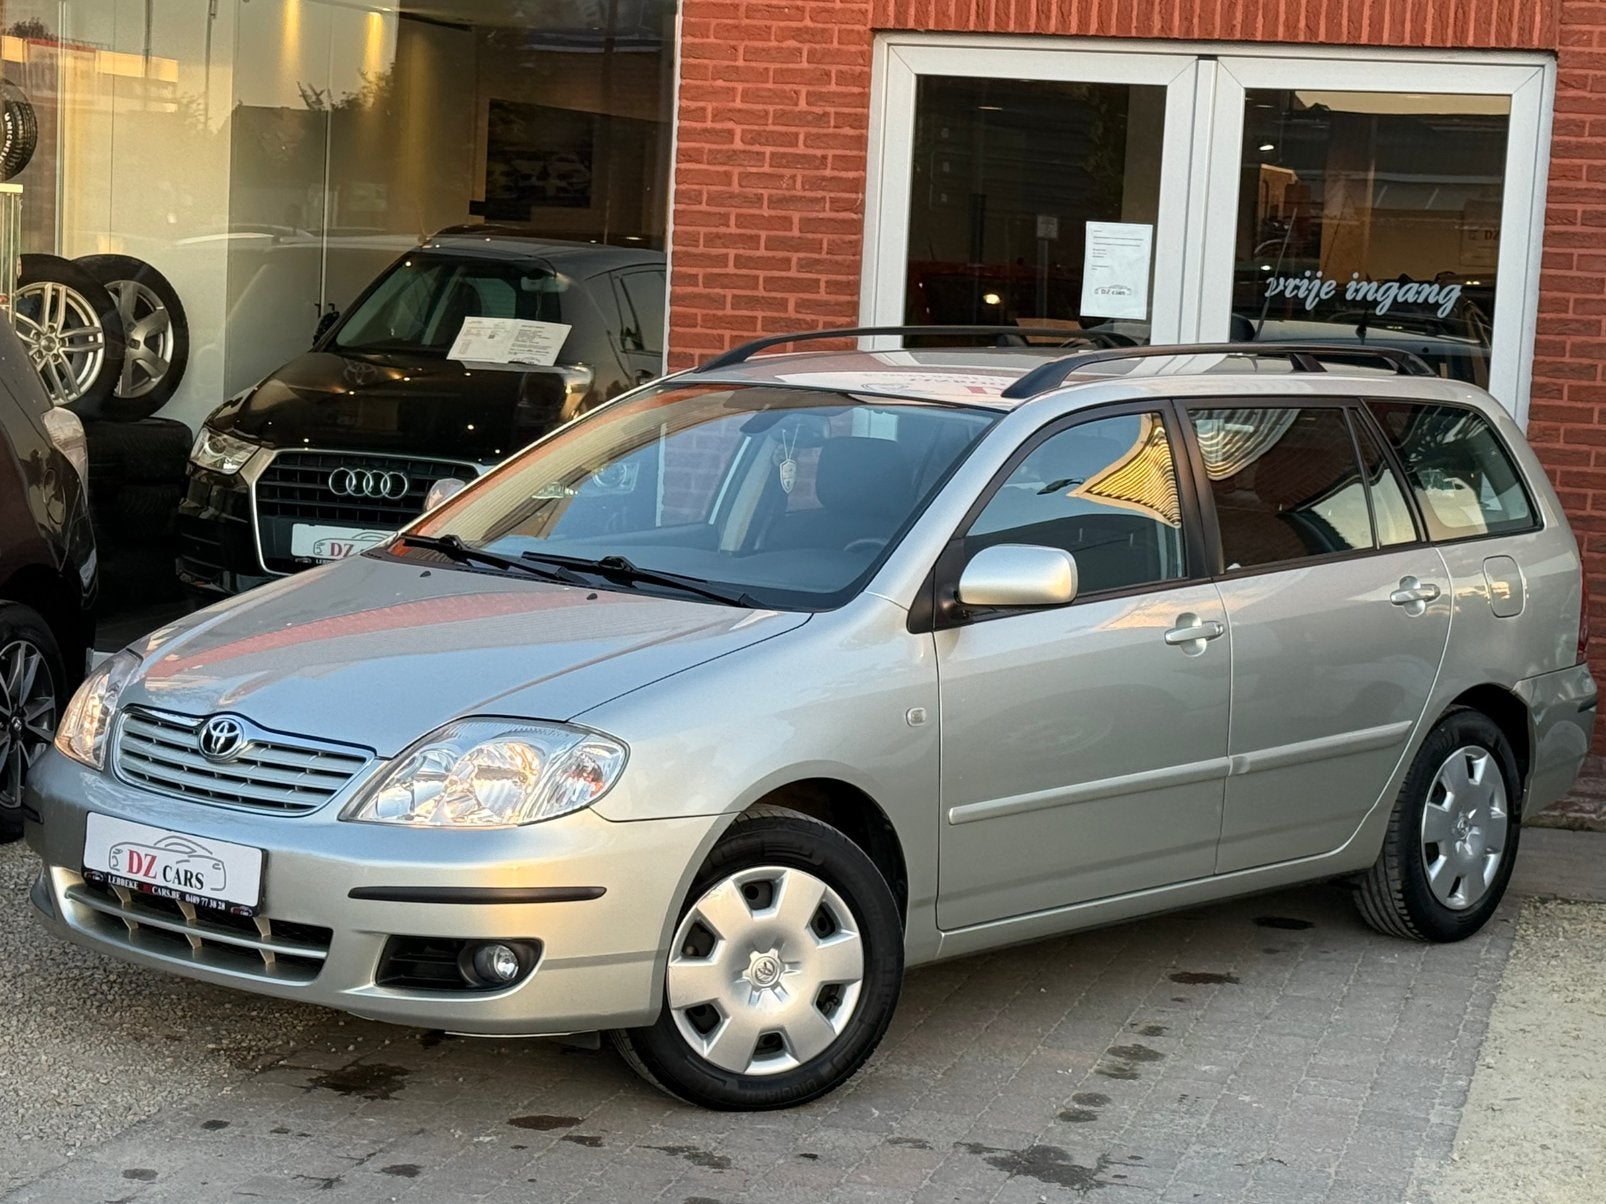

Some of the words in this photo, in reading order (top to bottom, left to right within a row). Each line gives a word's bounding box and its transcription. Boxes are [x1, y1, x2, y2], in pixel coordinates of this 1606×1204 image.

[1264, 270, 1337, 310] vrije
[1345, 272, 1462, 318] ingang
[330, 542, 354, 558] DZ
[127, 850, 157, 880] DZ
[163, 865, 205, 890] CARS
